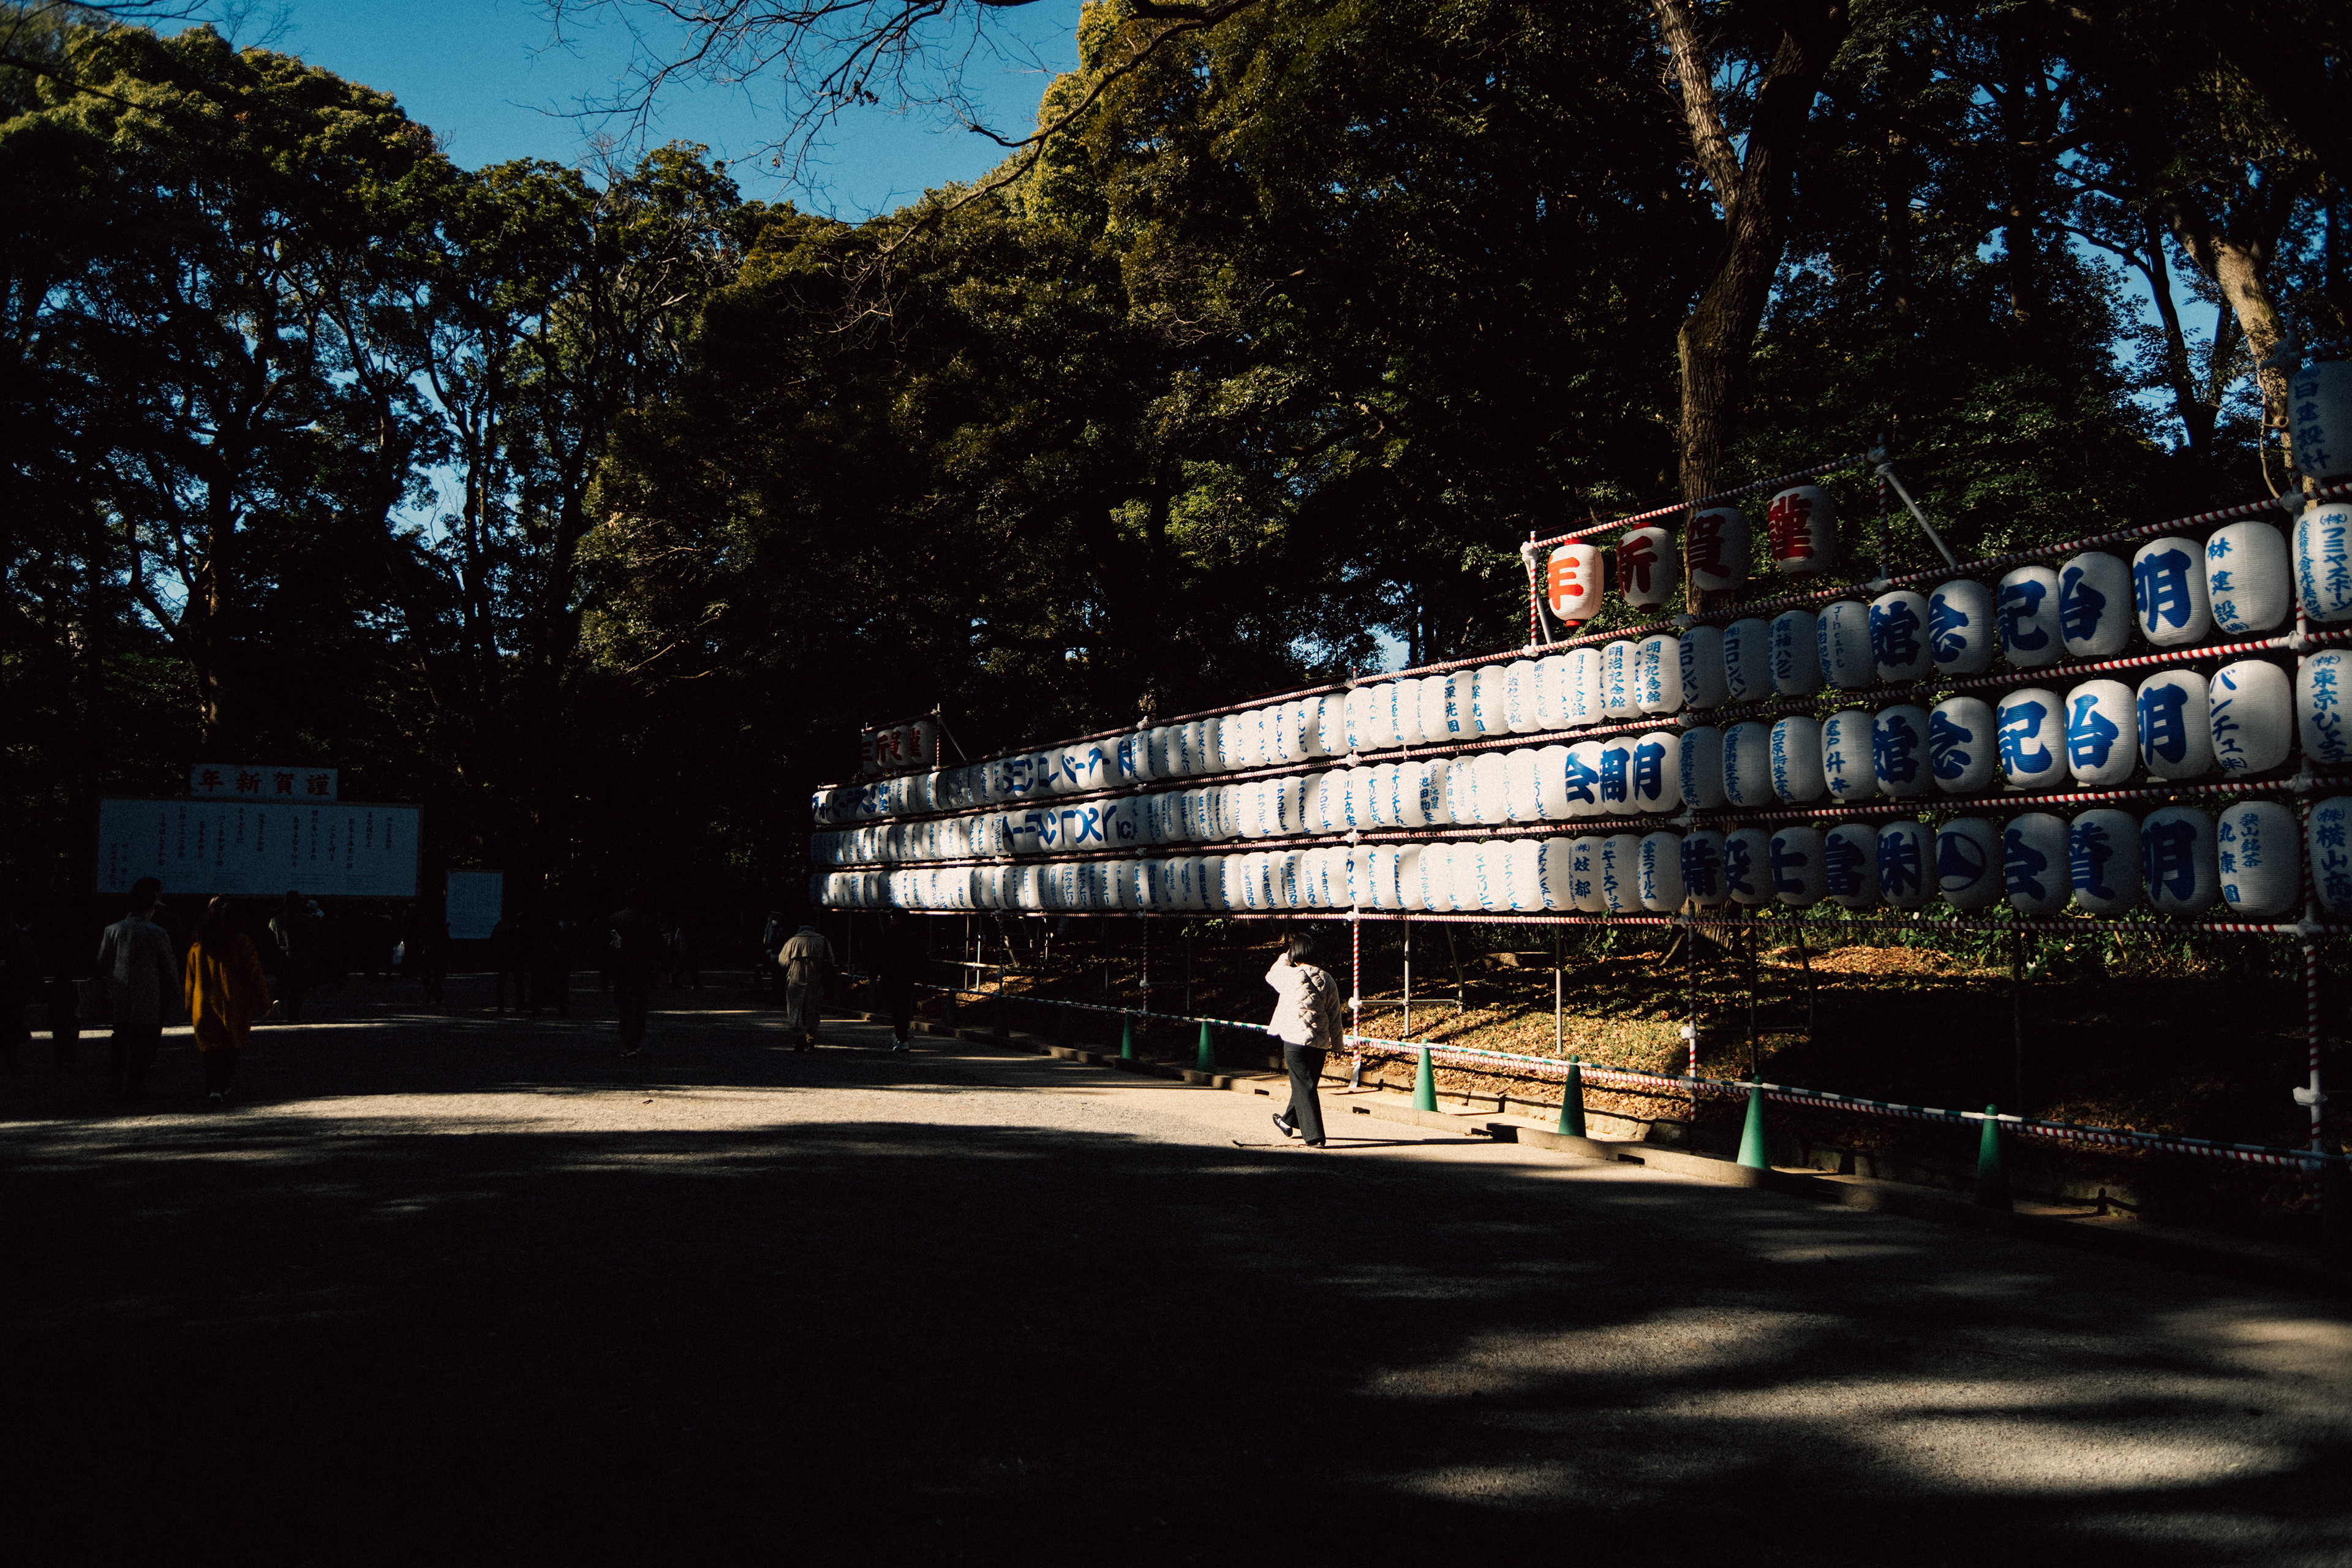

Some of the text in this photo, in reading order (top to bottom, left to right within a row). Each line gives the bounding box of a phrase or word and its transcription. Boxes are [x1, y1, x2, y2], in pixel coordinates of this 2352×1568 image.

[1608, 645, 1626, 708] 明治記念館
[1644, 640, 1662, 703] 明治記念館
[198, 769, 330, 795] 謹賀新年
